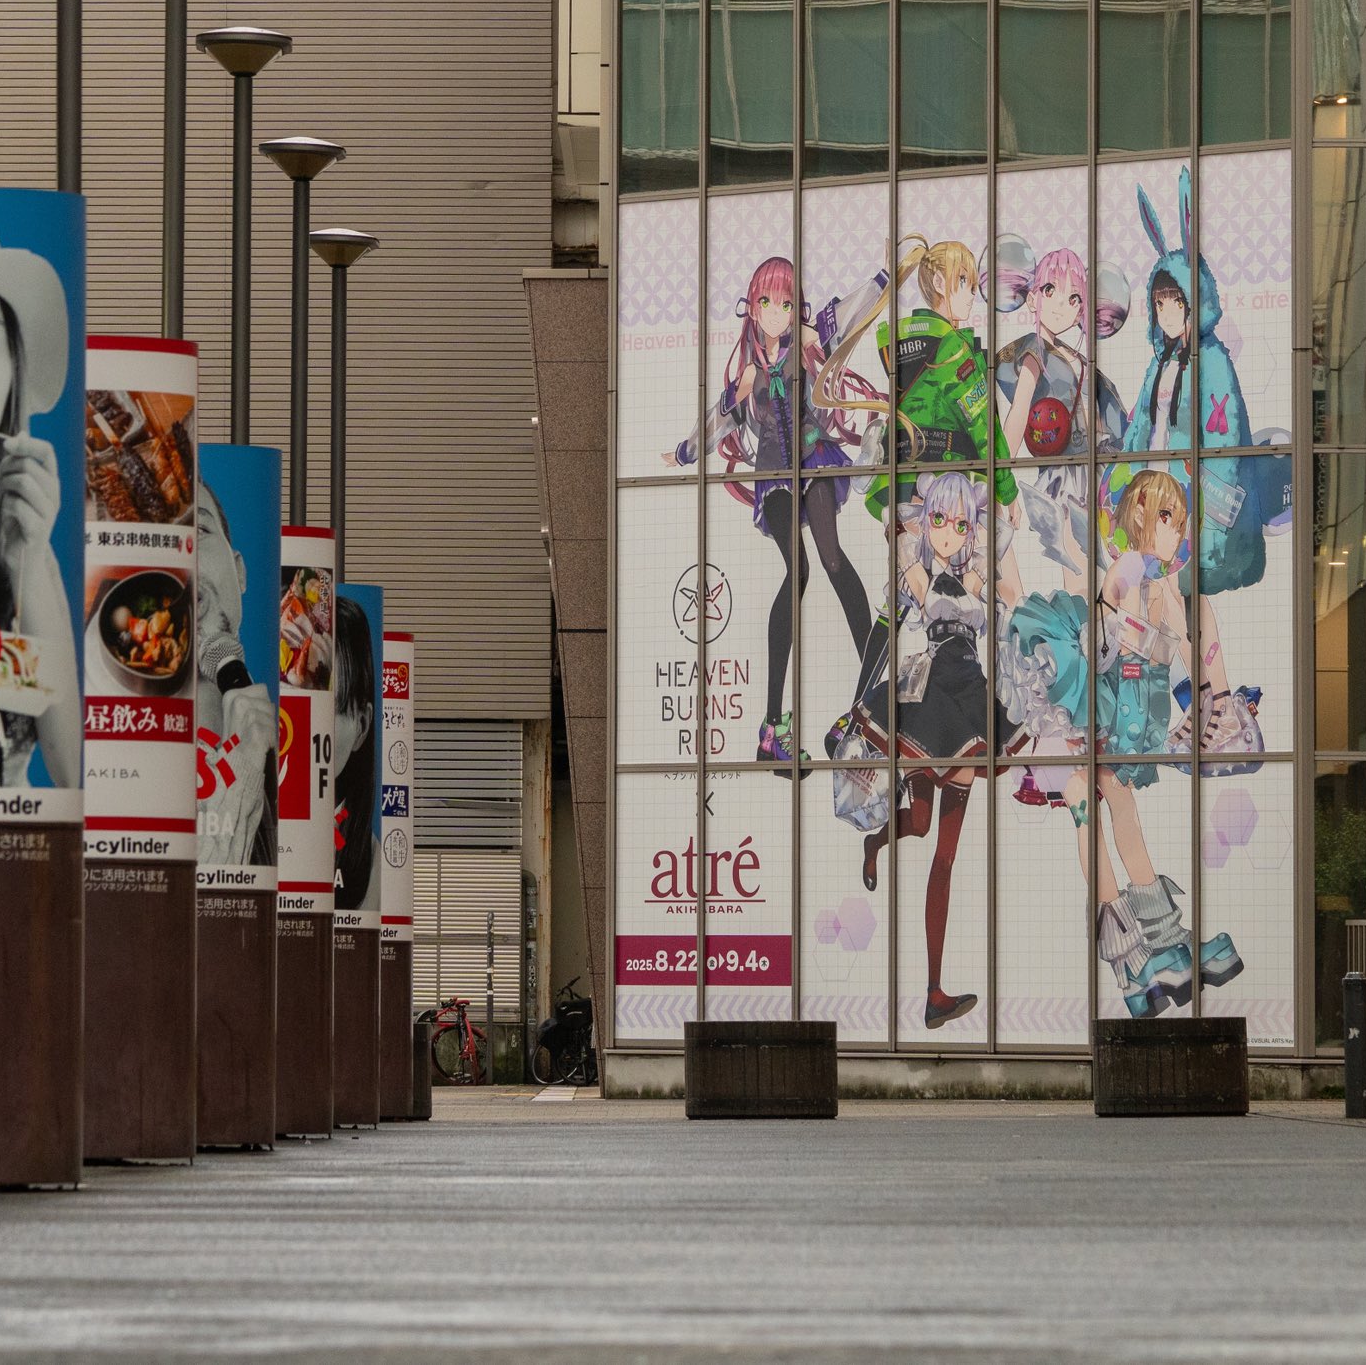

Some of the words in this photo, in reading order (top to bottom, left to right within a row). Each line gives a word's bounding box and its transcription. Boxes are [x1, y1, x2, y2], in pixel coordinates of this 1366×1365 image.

[622, 330, 686, 351] Heaven
[656, 658, 750, 688] HEAVEN
[85, 704, 159, 733] 昼飲み
[312, 732, 332, 765] 10
[87, 768, 141, 779] AKIBA
[690, 771, 718, 781] バンズ
[318, 767, 329, 799] F
[85, 838, 170, 855] -cylinder
[650, 835, 762, 899] atré
[197, 870, 256, 886] cylinder
[278, 895, 315, 910] linder
[665, 905, 744, 915] AKIHBARA
[380, 927, 398, 938] der
